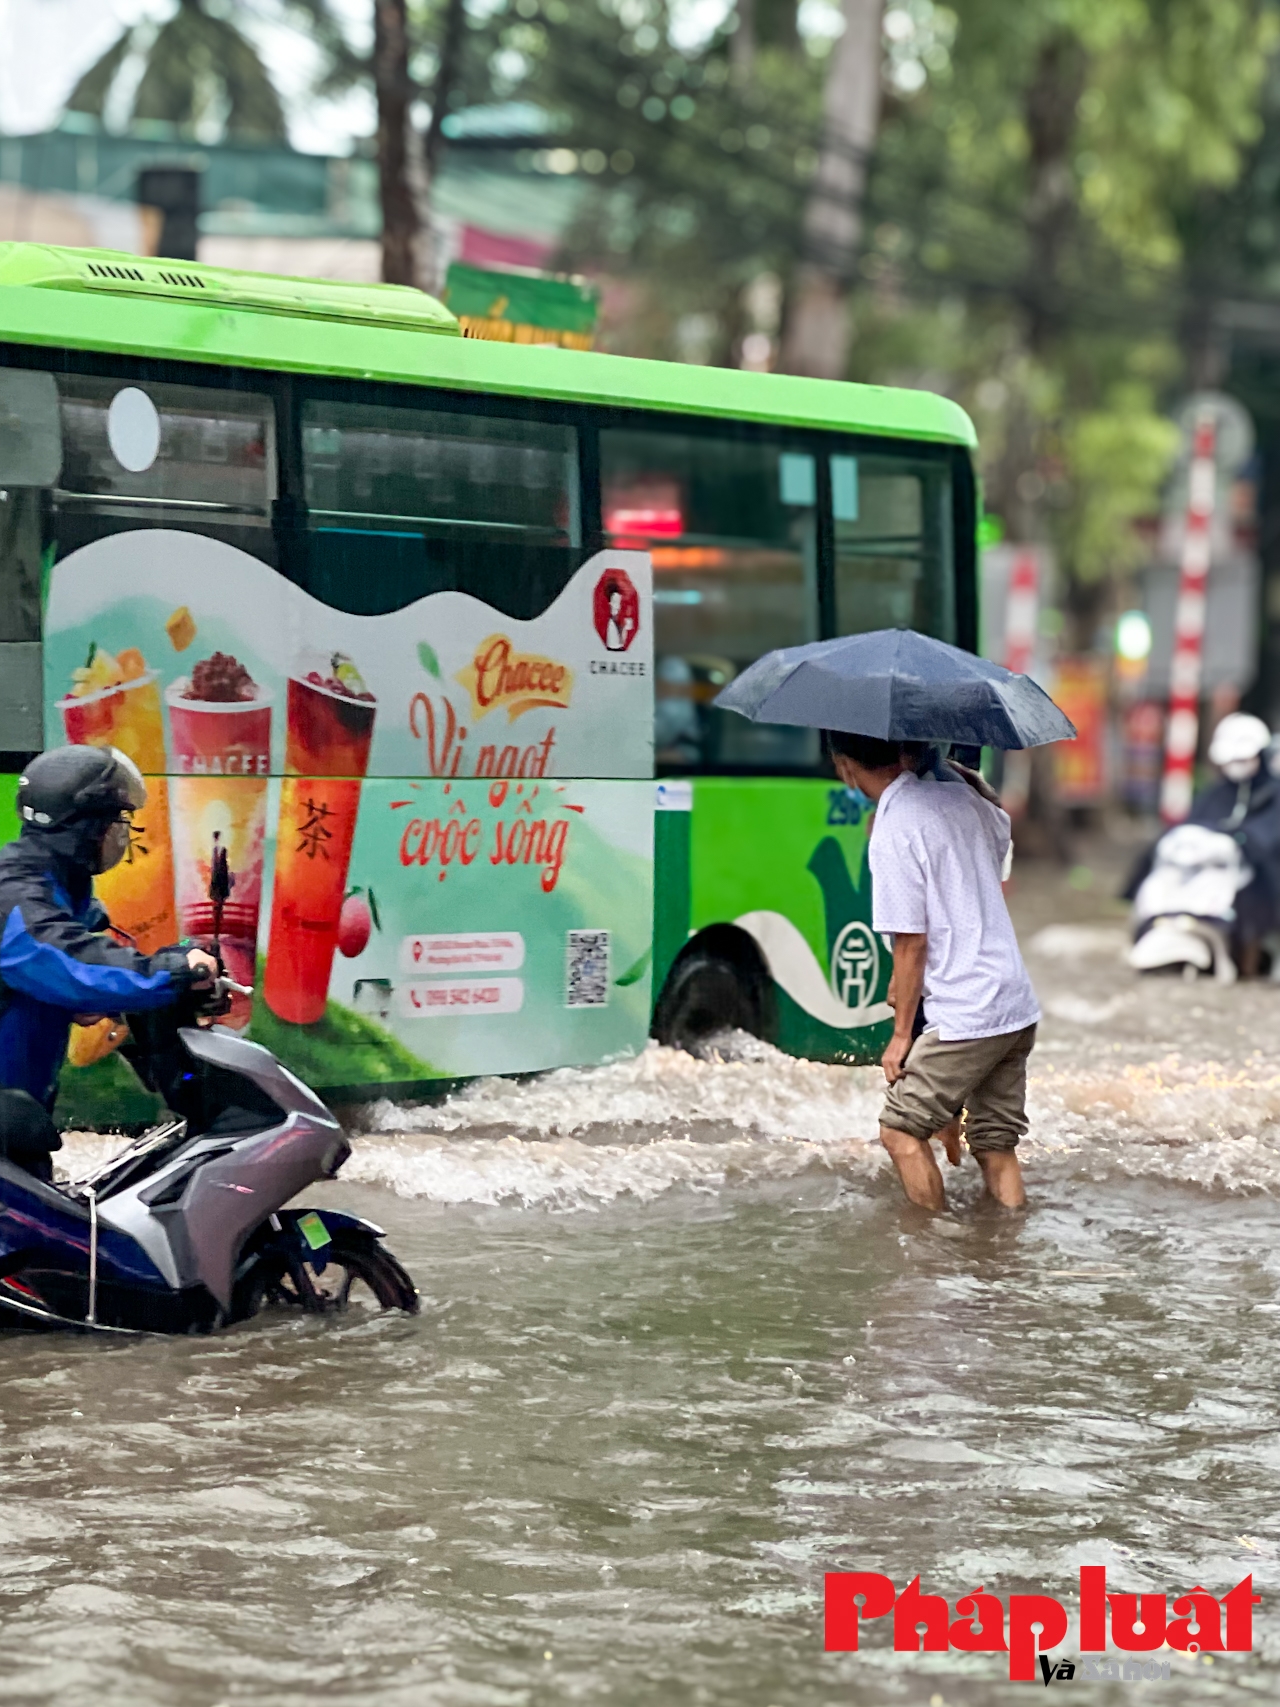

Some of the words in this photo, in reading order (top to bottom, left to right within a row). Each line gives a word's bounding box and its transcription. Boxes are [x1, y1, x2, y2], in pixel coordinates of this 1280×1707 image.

[475, 639, 566, 707] Chacee
[589, 660, 647, 677] CHACEE
[296, 797, 337, 861] 茶
